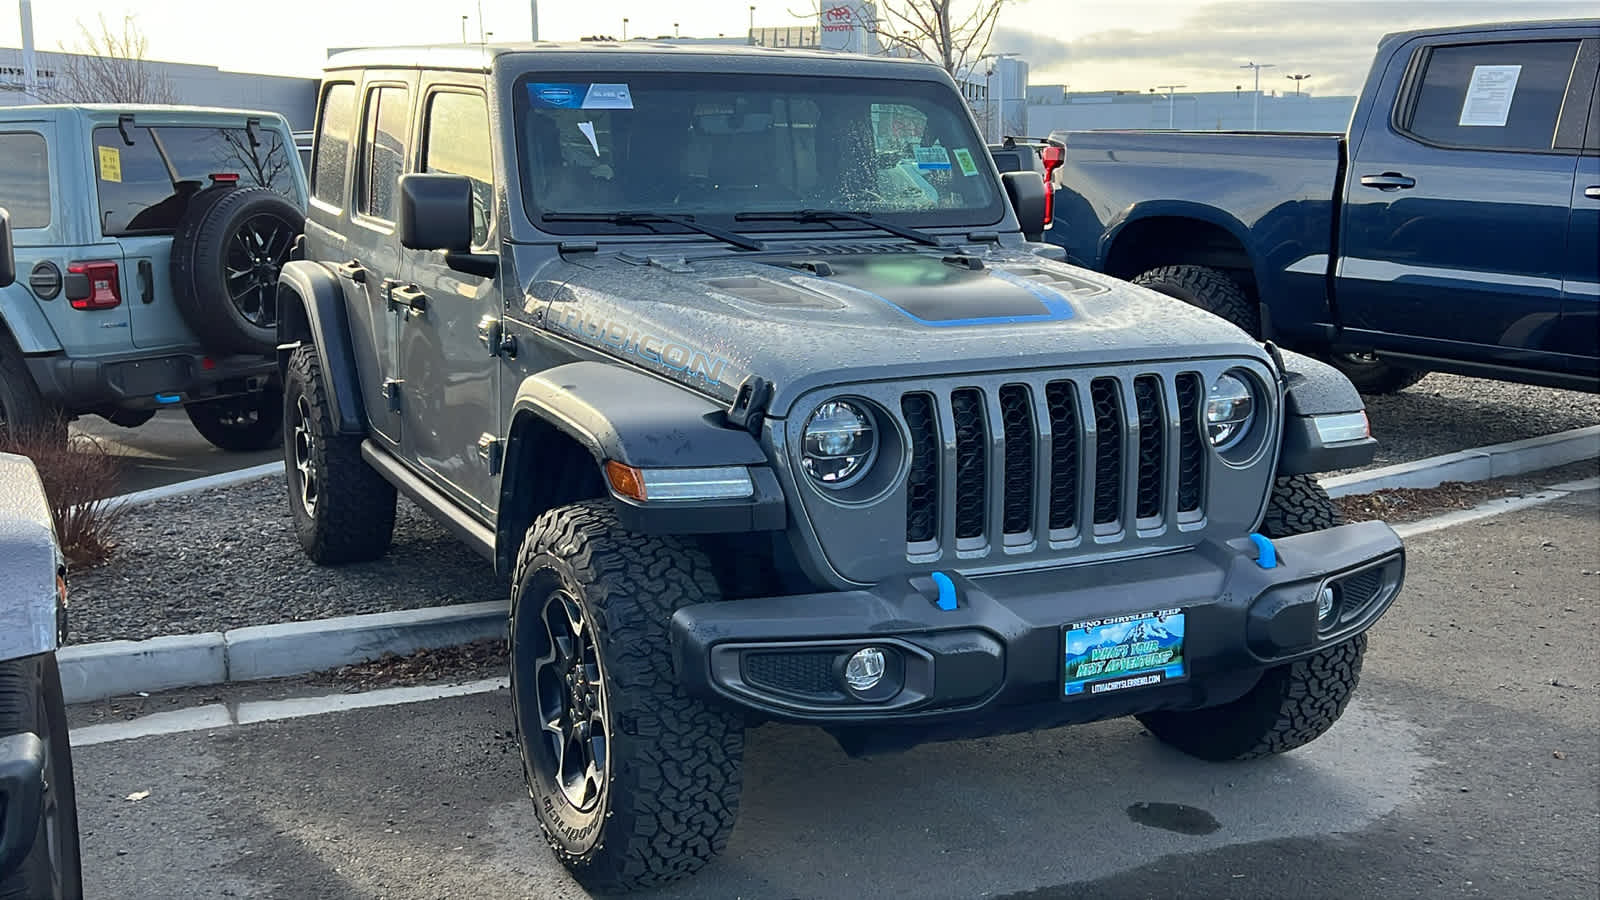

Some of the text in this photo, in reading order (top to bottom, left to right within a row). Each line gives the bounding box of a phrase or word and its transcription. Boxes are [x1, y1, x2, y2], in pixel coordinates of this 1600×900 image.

[560, 305, 727, 385] RUBICON
[1072, 607, 1181, 630] RENO CHRYSLER JEEP
[1131, 640, 1159, 656] YOUR
[1076, 650, 1173, 678] NEXT ADVENTURE?
